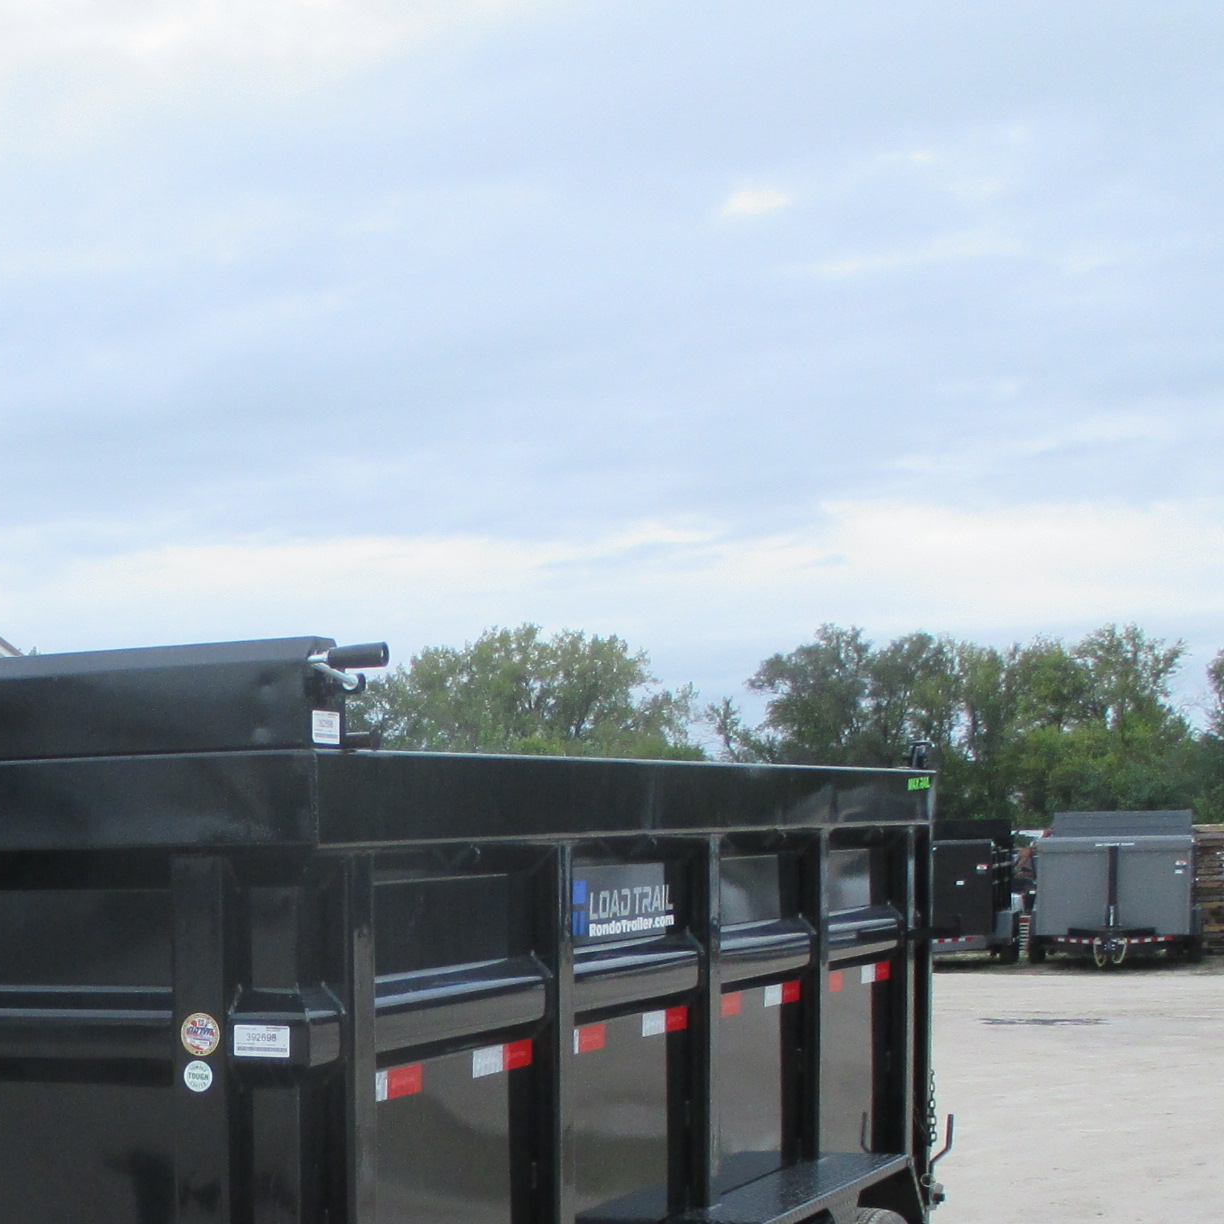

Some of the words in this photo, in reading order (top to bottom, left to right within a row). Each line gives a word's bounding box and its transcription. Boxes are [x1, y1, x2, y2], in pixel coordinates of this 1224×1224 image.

[589, 889, 631, 920] LOAD
[633, 884, 674, 914] TRAIL
[589, 914, 675, 937] RondoTrailer.com
